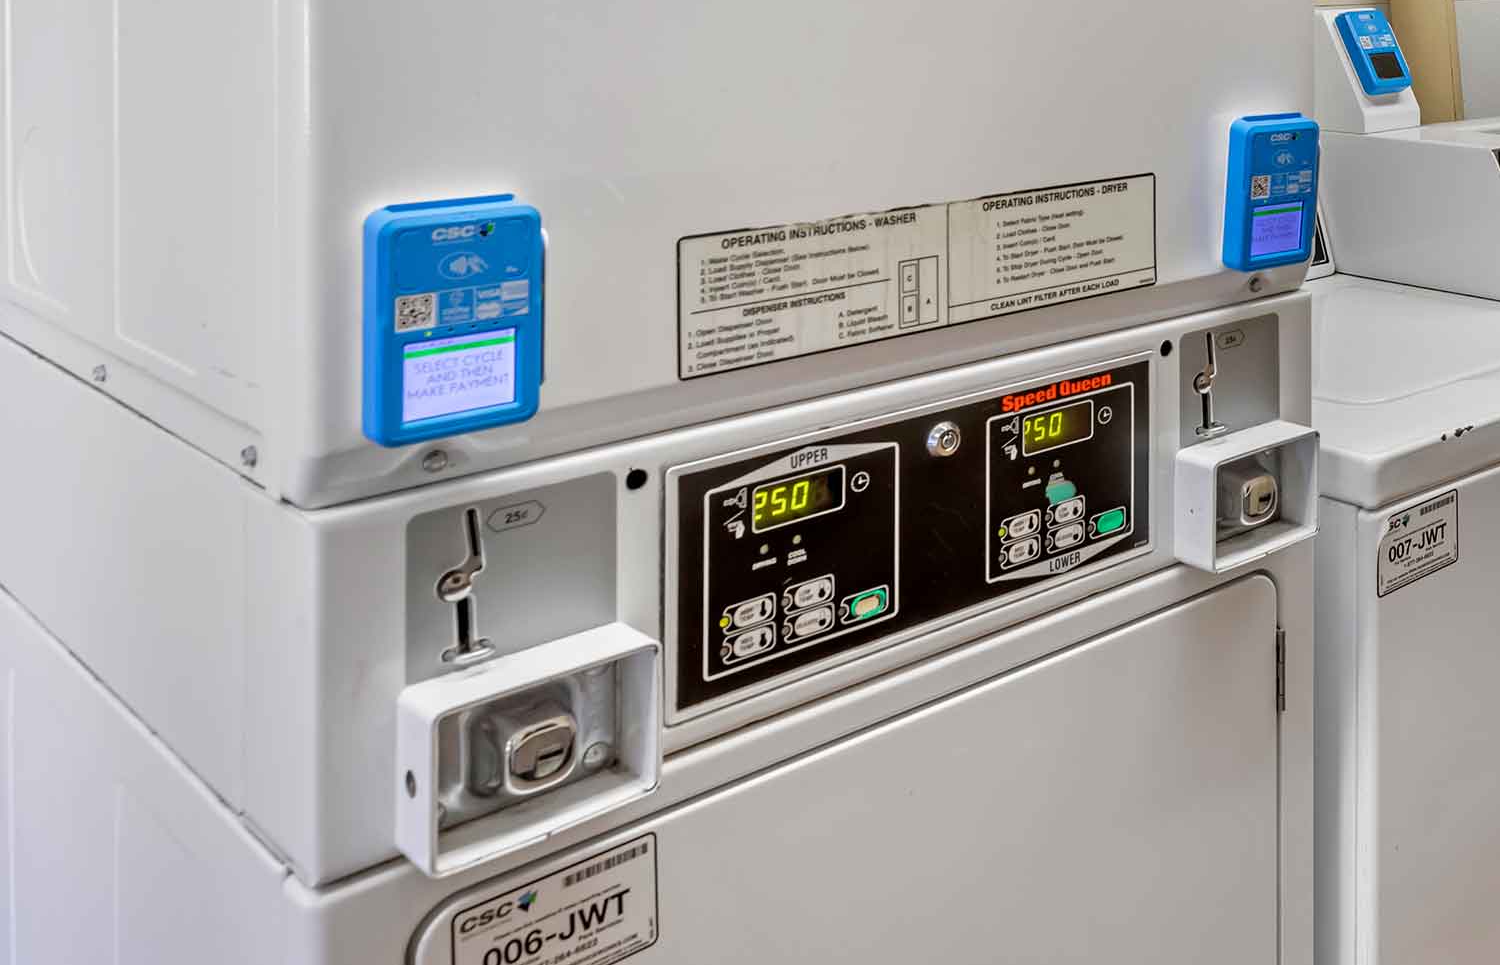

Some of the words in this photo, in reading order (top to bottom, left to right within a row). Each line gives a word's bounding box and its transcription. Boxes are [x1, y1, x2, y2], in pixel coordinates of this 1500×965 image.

[983, 195, 1033, 211] OPERATING
[1035, 187, 1095, 204] INSTRUCTIONS
[1102, 183, 1128, 194] DRYER
[431, 224, 475, 241] CSC
[721, 231, 786, 250] OPERATING
[789, 219, 867, 240] INSTRUCTIONS
[874, 212, 917, 228] WASHER
[742, 301, 788, 317] DISPENSER
[790, 291, 846, 308] INSTRUCTIONS
[991, 299, 1016, 311] CLEAN
[1017, 296, 1033, 306] LINT
[1034, 291, 1058, 303] FILTER
[1059, 286, 1081, 298] AFTER
[1083, 282, 1101, 293] EACH
[1102, 278, 1120, 290] LOAD
[413, 357, 461, 374] SELECT
[462, 349, 504, 366] CYCLE
[426, 369, 457, 384] AND
[460, 364, 494, 378] THEN
[406, 381, 446, 399] MAKE
[447, 372, 509, 395] PAYMENT
[1002, 382, 1057, 412] Speed
[1059, 373, 1112, 397] Queen
[790, 447, 828, 469] UPPER
[1388, 522, 1447, 563] 007-JWT
[1049, 551, 1082, 572] LOWER
[460, 901, 513, 934] CSC
[483, 888, 631, 965] 006-JWT
